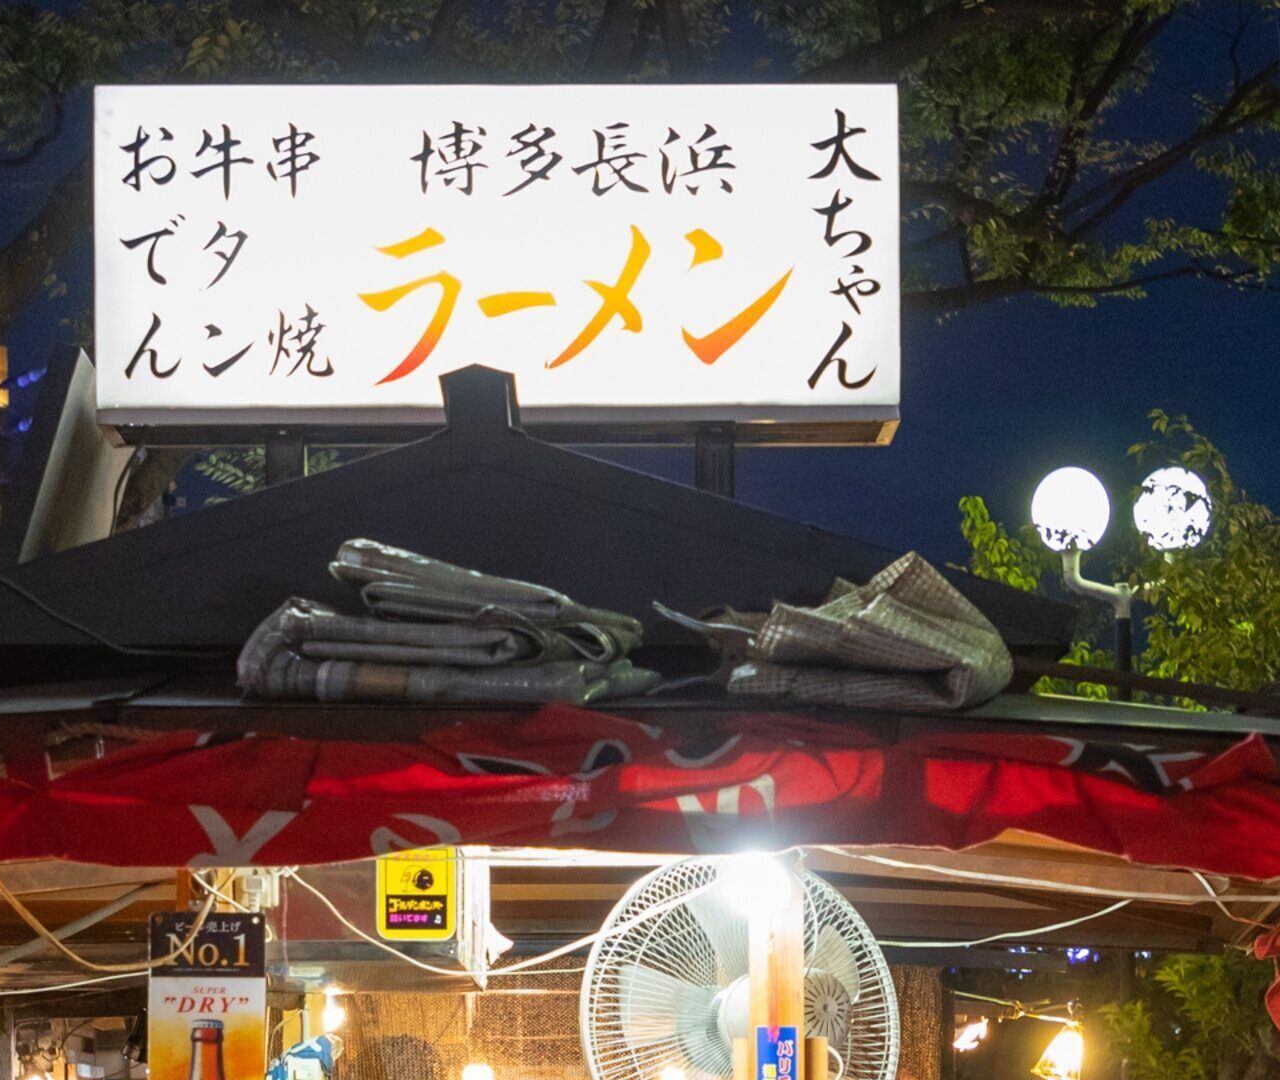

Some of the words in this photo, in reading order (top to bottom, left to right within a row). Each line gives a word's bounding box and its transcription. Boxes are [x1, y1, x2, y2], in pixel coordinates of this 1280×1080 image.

[410, 120, 737, 198] 博多長浜
[120, 124, 186, 380] おでん
[189, 123, 255, 378] 牛タン
[266, 122, 334, 378] 串焼
[357, 224, 793, 385] ラーメン
[807, 108, 883, 390] 大ちゃん
[166, 933, 250, 967] No.1
[175, 921, 241, 933] ビー売上げ
[192, 986, 227, 995] SUPER
